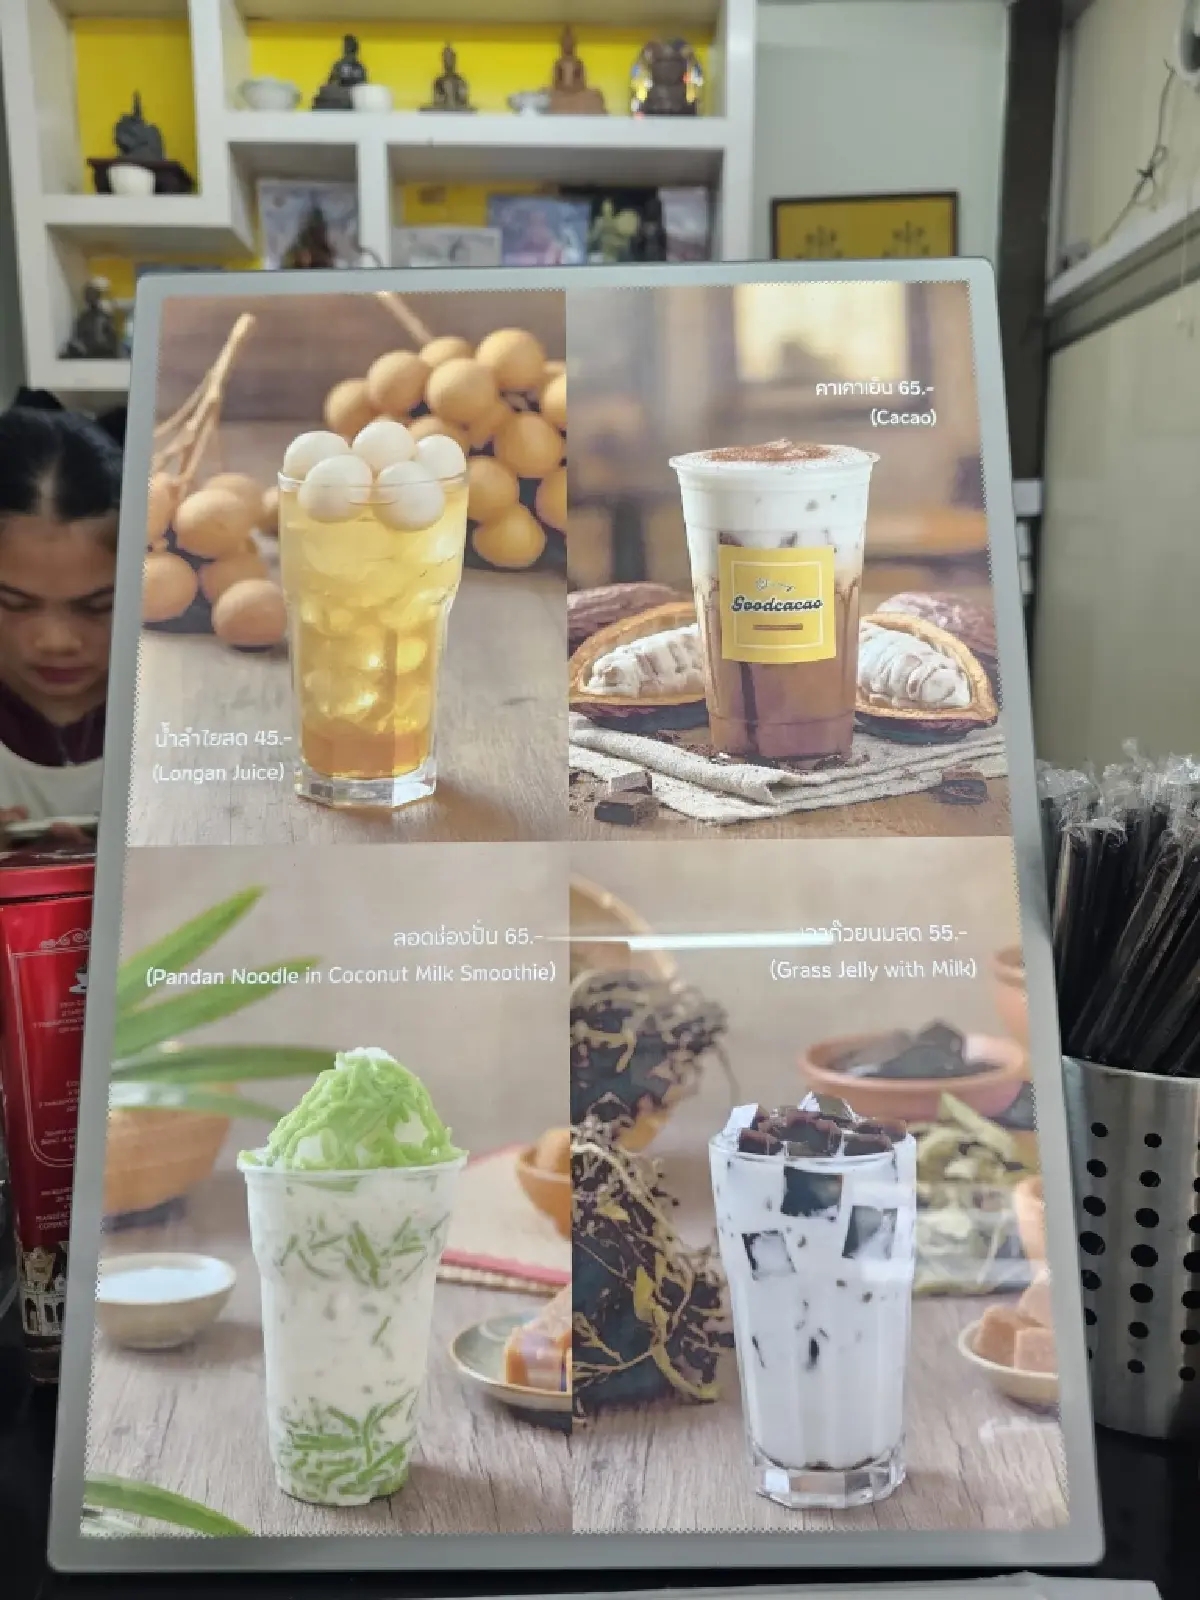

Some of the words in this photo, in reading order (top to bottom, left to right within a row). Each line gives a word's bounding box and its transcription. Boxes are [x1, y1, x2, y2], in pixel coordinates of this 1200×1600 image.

[898, 381, 935, 396] 65.-
[871, 408, 937, 427] (Cacao)
[155, 721, 248, 748] น้ำลำไยสด
[254, 730, 293, 746] 45.-
[152, 763, 226, 784] (Longan
[232, 762, 285, 782] Juice)
[393, 918, 499, 946] ลอดช่องปั่น
[505, 927, 544, 946] 65.-
[929, 925, 968, 942] 55.-
[146, 966, 224, 987] (Pandan
[231, 967, 298, 985] Noodle
[305, 966, 321, 983] in
[329, 965, 409, 983] Coconut
[415, 964, 454, 982] Milk
[460, 961, 556, 983] Smoothie)
[770, 958, 831, 981] (Grass
[838, 960, 878, 982] Jelly
[884, 960, 925, 979] with
[932, 957, 977, 979] Milk)
